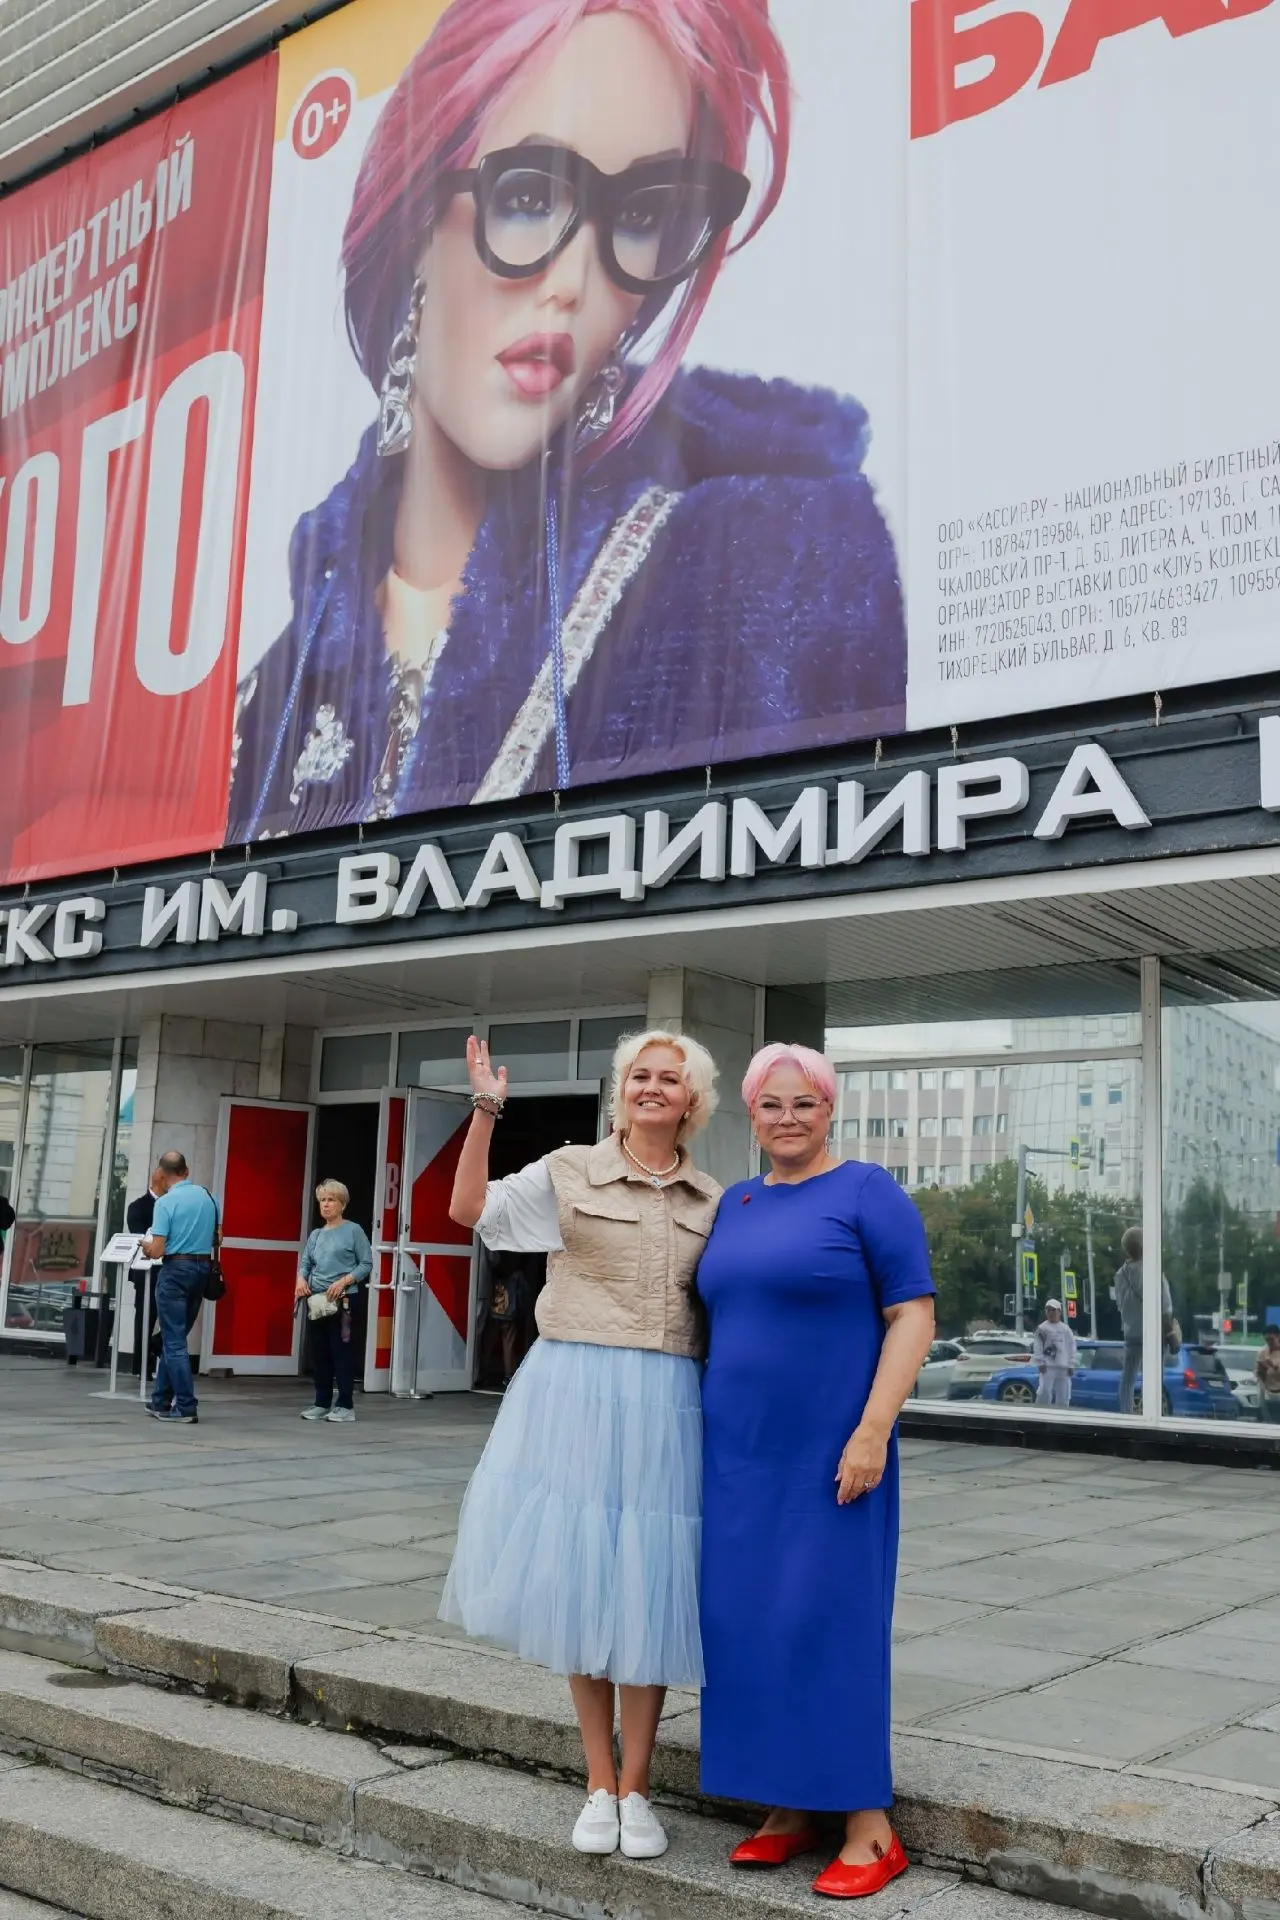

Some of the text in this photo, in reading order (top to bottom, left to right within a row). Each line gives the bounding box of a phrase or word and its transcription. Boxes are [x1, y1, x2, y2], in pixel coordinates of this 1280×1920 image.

[910, 0, 1276, 140] БА
[301, 97, 347, 146] 0+
[0, 263, 138, 419] МПЛЕКС
[0, 350, 245, 706] ОГО
[938, 519, 963, 543] ООО
[1064, 461, 1187, 512] НАЦИОНАЛЬНЫЙ
[1194, 440, 1280, 483] БИЛЕТНЫЙ
[1090, 512, 1114, 535] ЮР.
[1120, 498, 1173, 529] АДРЕС:
[1179, 485, 1235, 515] 197136,
[938, 556, 1028, 597] ЧКАЛОВСКИЙ
[1120, 527, 1177, 559] ЛИТЕРА
[938, 587, 1031, 626] ОРГАНИЗАТОР
[1036, 570, 1112, 606] ВЫСТАВКИ
[1118, 563, 1148, 588] ООО
[1153, 551, 1203, 578] «КЛУБ
[938, 642, 1027, 681] ТИХОРЕЦКИЙ
[1141, 620, 1165, 643] КВ.
[1171, 615, 1187, 639] 83
[1061, 603, 1102, 630] ОГРН:
[140, 871, 298, 948] ИМ.
[336, 743, 1153, 924] ВЛАДИМИРА
